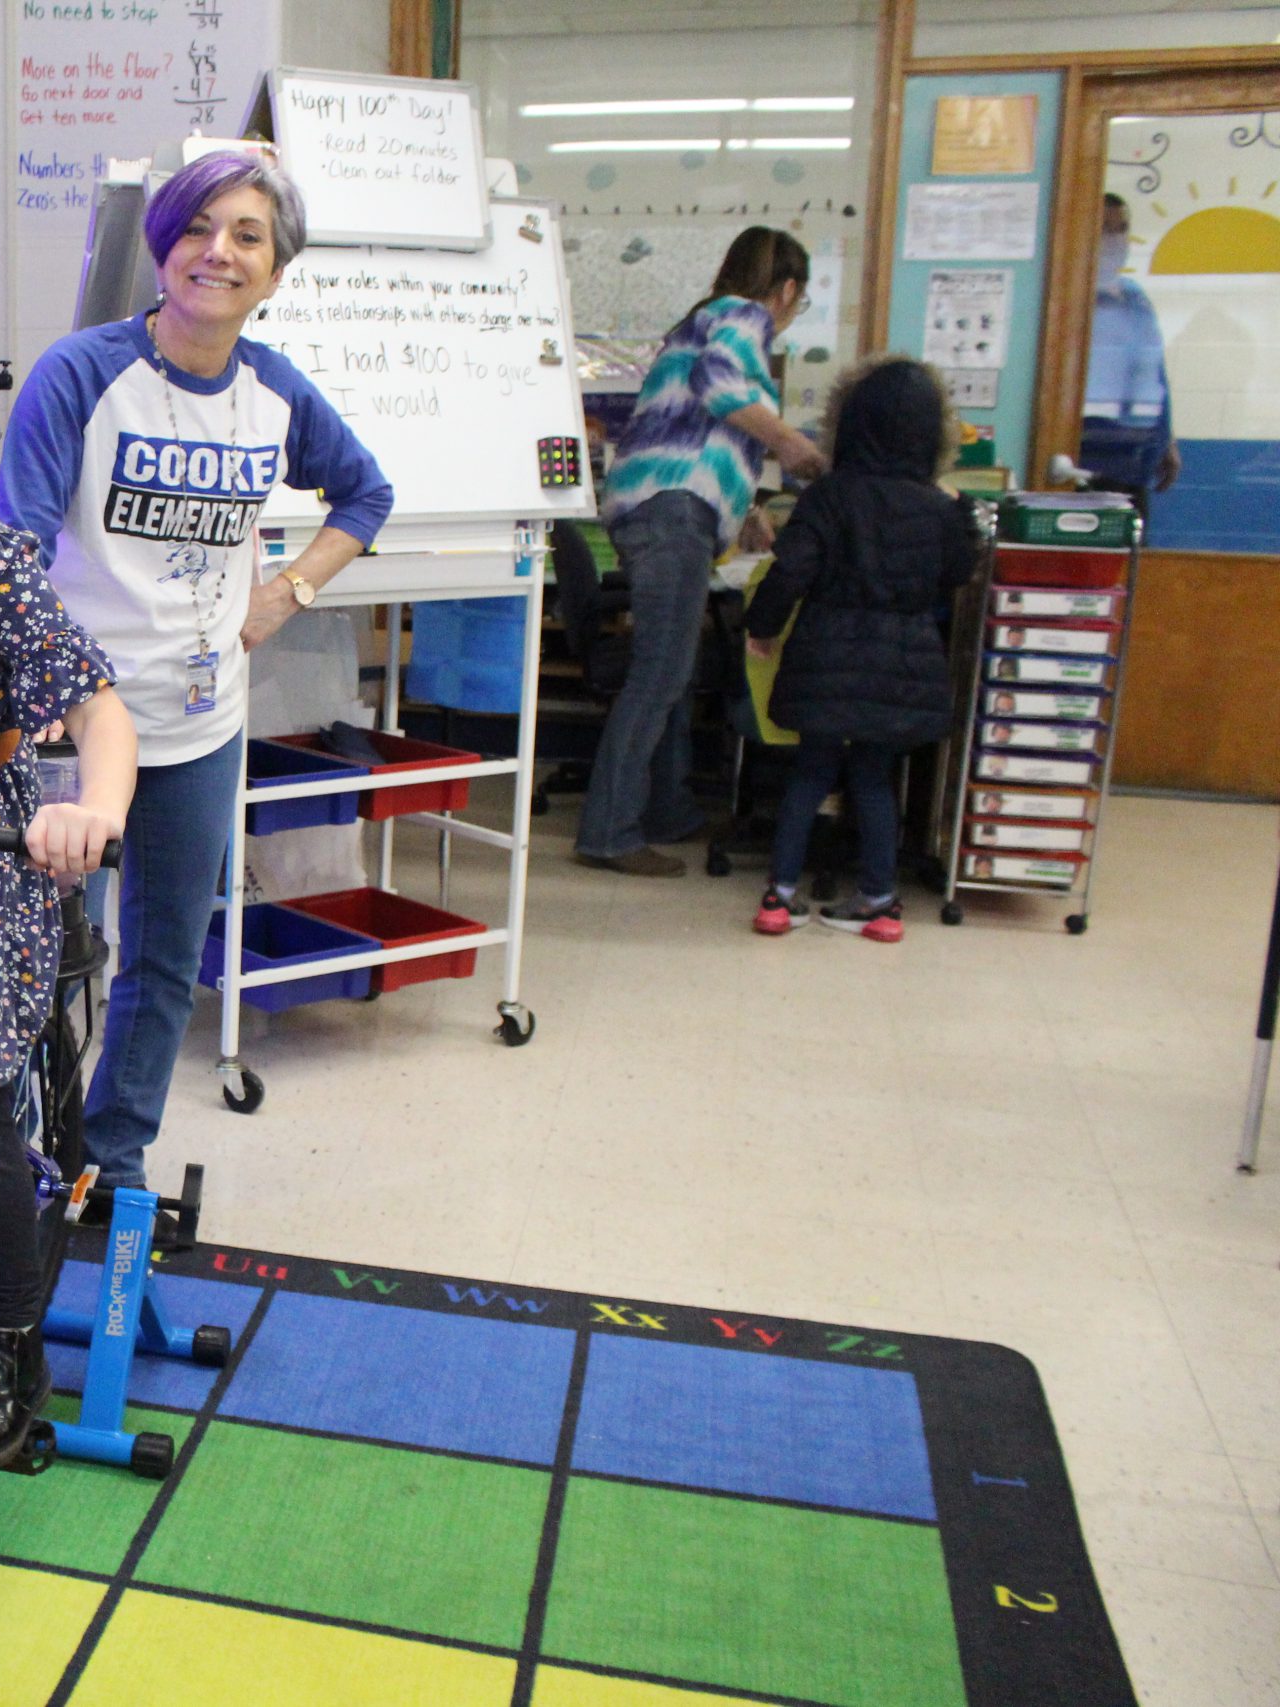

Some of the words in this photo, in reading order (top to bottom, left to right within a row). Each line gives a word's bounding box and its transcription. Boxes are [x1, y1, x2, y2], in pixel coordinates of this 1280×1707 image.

[23, 1, 45, 20] No
[53, 0, 93, 20] need
[101, 2, 115, 20] to
[122, 3, 158, 26] stop
[22, 57, 56, 80] More
[63, 64, 80, 79] on
[86, 53, 114, 79] the
[123, 52, 174, 80] floor?
[21, 80, 39, 102] Go
[44, 84, 76, 99] next
[83, 84, 111, 99] door
[118, 85, 143, 100] and
[20, 109, 45, 124] Get
[52, 110, 77, 125] ten
[83, 111, 118, 125] more
[190, 106, 215, 124] 28
[291, 89, 345, 123] Happy
[408, 97, 453, 135] Day!
[326, 133, 366, 154] Read
[18, 150, 84, 180] Numbers
[328, 159, 368, 179] Clean
[375, 166, 400, 179] out
[414, 163, 460, 185] folder
[17, 188, 58, 210] Zero's
[292, 268, 305, 290] of
[313, 270, 339, 298] your
[348, 270, 380, 289] roles
[387, 270, 424, 293] within
[430, 279, 453, 300] your
[277, 301, 312, 323] roles
[327, 299, 407, 326] relationships
[411, 302, 434, 322] with
[440, 303, 477, 324] others
[480, 307, 512, 333] change
[343, 341, 388, 373] had
[402, 342, 451, 375] $100
[463, 353, 488, 378] to
[497, 362, 538, 396] give
[371, 385, 441, 418] would
[122, 440, 277, 492] COOKE
[114, 1229, 135, 1274] BIKE
[213, 1253, 288, 1281] Uu
[330, 1267, 401, 1295] Vv
[110, 1274, 123, 1296] THE
[440, 1282, 550, 1314] Ww
[105, 1293, 128, 1337] ROCK
[589, 1302, 668, 1331] Xx
[708, 1316, 784, 1349] Yy
[825, 1331, 905, 1360] Zz
[993, 1583, 1059, 1613] 2
